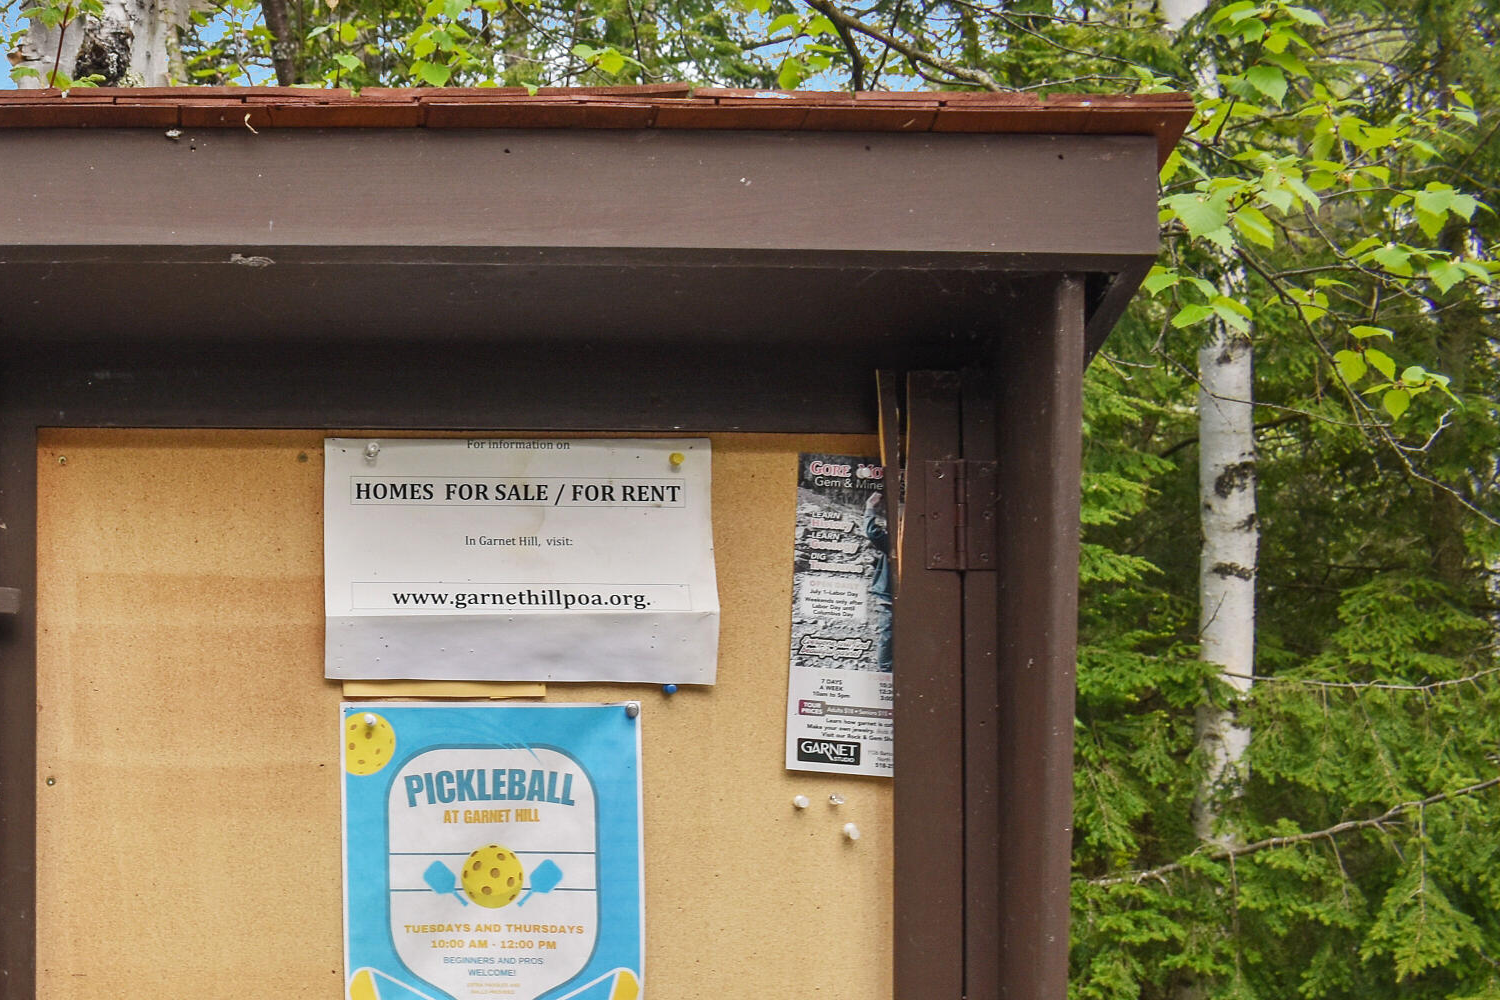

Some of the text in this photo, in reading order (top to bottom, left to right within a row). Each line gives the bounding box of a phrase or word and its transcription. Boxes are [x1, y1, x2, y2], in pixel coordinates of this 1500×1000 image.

[467, 439, 570, 449] For information on
[814, 476, 841, 487] Gem
[844, 478, 853, 488] &
[355, 484, 680, 505] HOMES FOR SALE / FOR RENT
[811, 511, 840, 519] LEARN
[465, 535, 572, 546] In Garnet Hill, visit:
[811, 532, 840, 540] LEARN
[811, 552, 827, 560] DIG
[392, 590, 650, 610] www.garnethillpoa.org.
[801, 741, 858, 757] GARNET
[403, 768, 576, 808] PICKLEBALL
[443, 808, 540, 824] AT GARNET HILL
[403, 923, 584, 934] TUESDAYS AND THURSDAYS
[431, 938, 464, 948] 10:00
[468, 939, 488, 948] AM
[500, 939, 534, 949] 12:00
[537, 940, 556, 949] PM
[443, 956, 495, 964] BEGINNERS
[467, 968, 516, 976] WELCOME!
